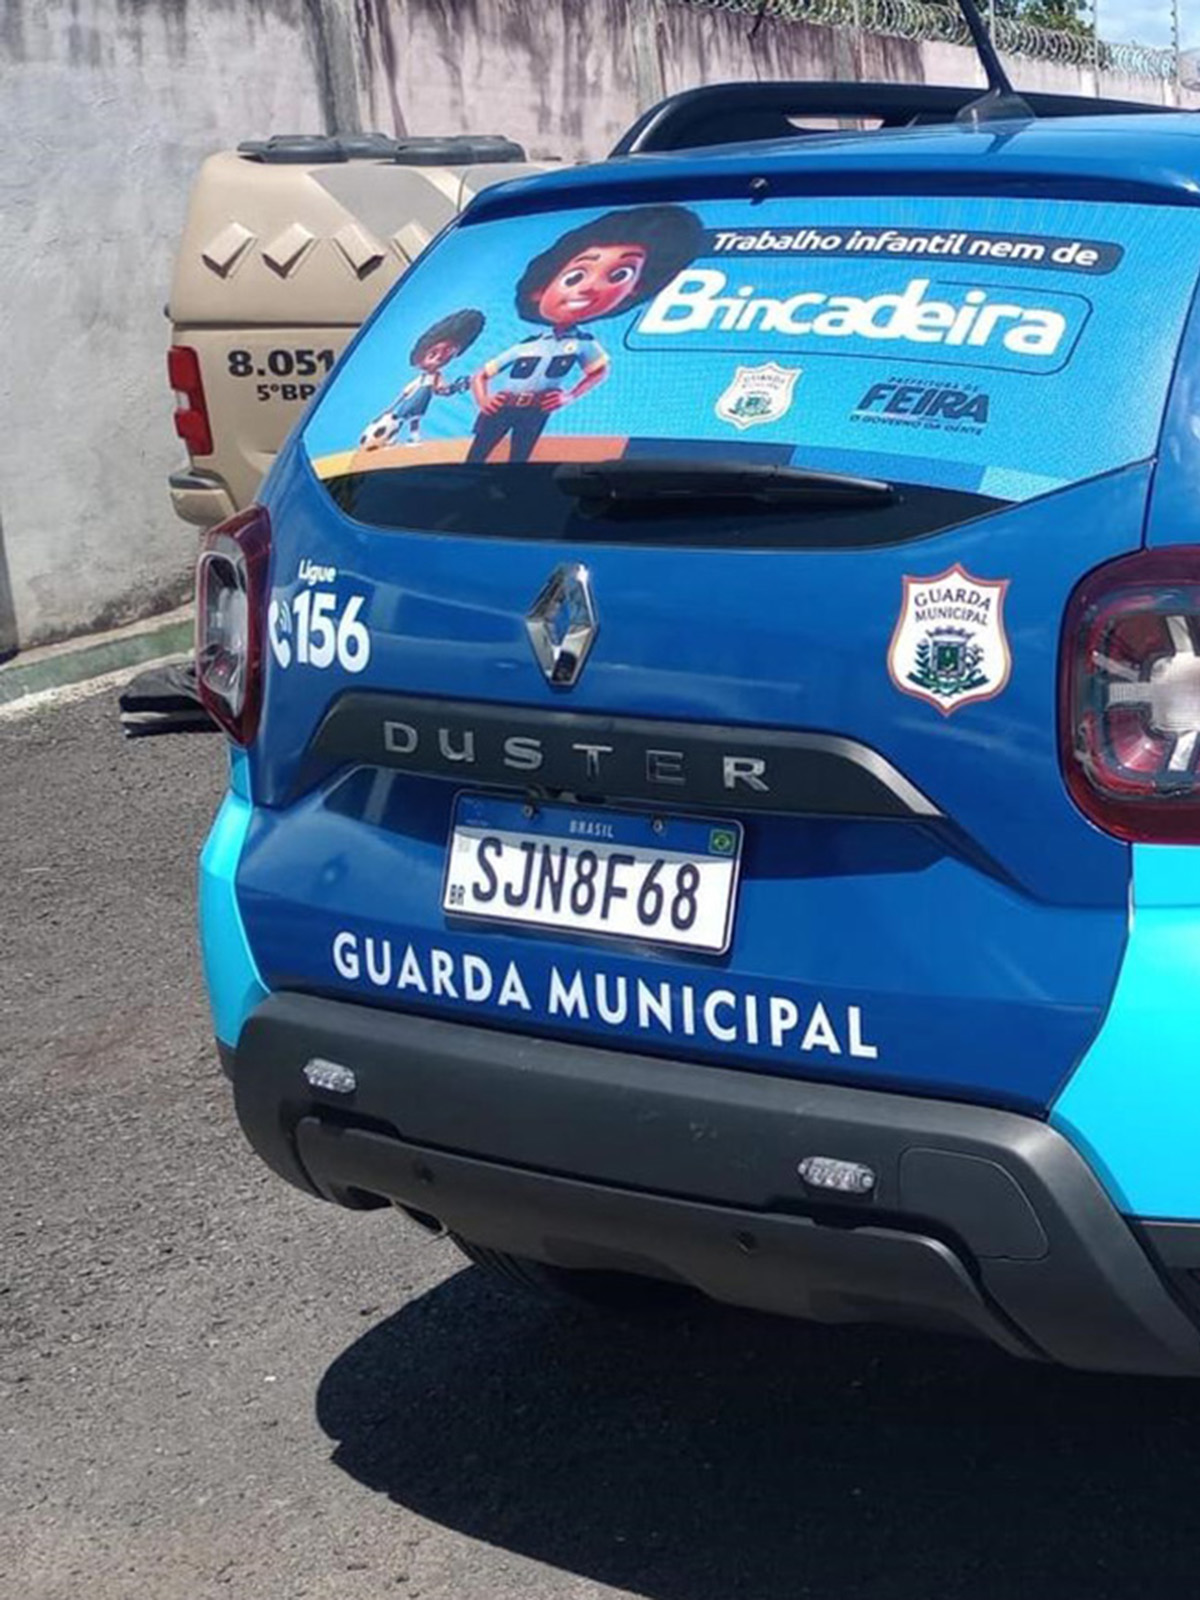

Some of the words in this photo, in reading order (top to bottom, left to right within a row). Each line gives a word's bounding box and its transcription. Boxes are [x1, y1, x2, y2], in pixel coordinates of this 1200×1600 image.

[713, 230, 842, 252] Trabalho
[846, 230, 962, 255] infantil
[968, 237, 1044, 260] nem
[1052, 242, 1098, 266] de
[636, 268, 1068, 357] Brincadeira
[857, 382, 990, 424] FEIRA
[298, 558, 337, 587] Ligue
[914, 588, 991, 612] GUARDA
[915, 606, 989, 627] MUNICIPAL
[292, 589, 370, 674] 156
[384, 720, 770, 792] DUSTER
[569, 820, 614, 838] BRASIL
[472, 836, 701, 931] SJN8F68
[332, 932, 532, 1011] GUARDA
[548, 966, 878, 1059] MUNICIPAL
